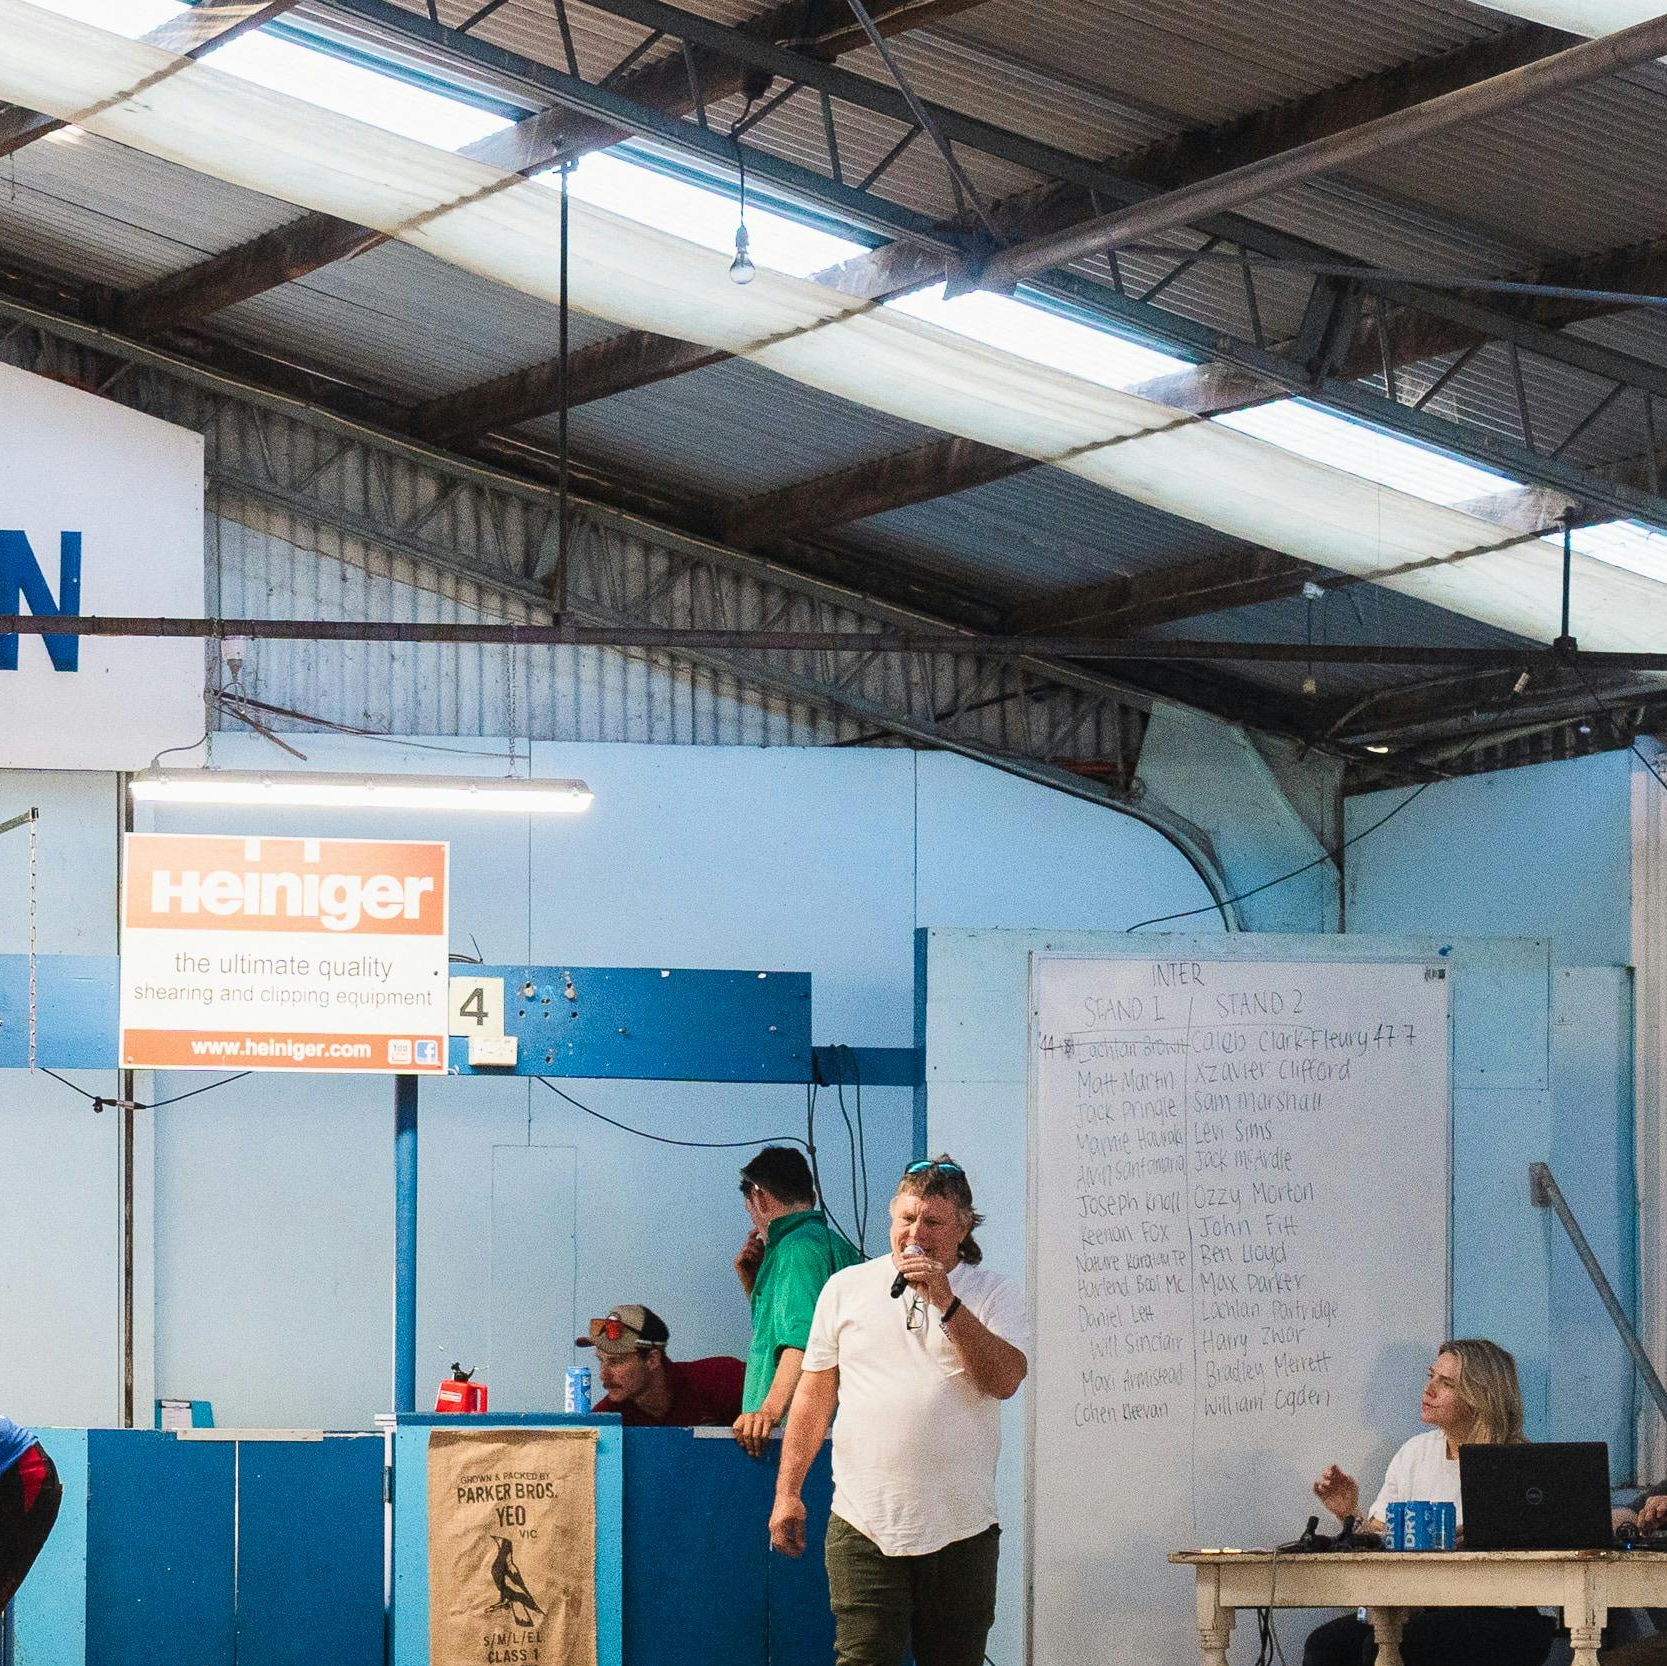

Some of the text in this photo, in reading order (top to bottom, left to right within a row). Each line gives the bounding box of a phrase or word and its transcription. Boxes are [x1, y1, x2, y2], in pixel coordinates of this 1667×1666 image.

[151, 848, 434, 930] Heiniger
[175, 952, 393, 982] the ultimate quality
[1152, 962, 1205, 987] INTER
[133, 983, 433, 1009] shearing and clipping equipment
[459, 988, 489, 1026] 4
[1216, 988, 1303, 1019] STAND 2
[1084, 996, 1144, 1027] STAND
[190, 1038, 373, 1060] www.heiniger.com
[1191, 1030, 1247, 1053] Caleb
[1278, 1058, 1351, 1082] Clifford
[1077, 1069, 1175, 1098] Matt Martin
[1193, 1090, 1232, 1113] Sam
[1076, 1102, 1115, 1128] Jack
[1235, 1119, 1272, 1141] Sims
[1194, 1149, 1228, 1172] Jack
[1252, 1182, 1314, 1204] Morton
[1076, 1192, 1139, 1219] Joseph
[1199, 1214, 1251, 1238] John
[1199, 1243, 1233, 1266] Ben
[1200, 1272, 1237, 1296] Max
[1078, 1304, 1124, 1333] Daniel
[1202, 1300, 1260, 1321] Lachlan
[1124, 1331, 1184, 1355] Sinclair
[1202, 1328, 1248, 1357] Harry
[1207, 1359, 1266, 1397] Bradley
[1074, 1401, 1117, 1427] Cohen
[1204, 1395, 1264, 1417] William
[460, 1474, 493, 1484] GROWN
[503, 1472, 537, 1481] PACKED
[539, 1472, 551, 1481] BY
[457, 1482, 558, 1504] PARKER BROS.
[495, 1505, 526, 1528] YEO
[1404, 1509, 1417, 1550] DRY
[488, 1648, 539, 1664] CLASS 1
